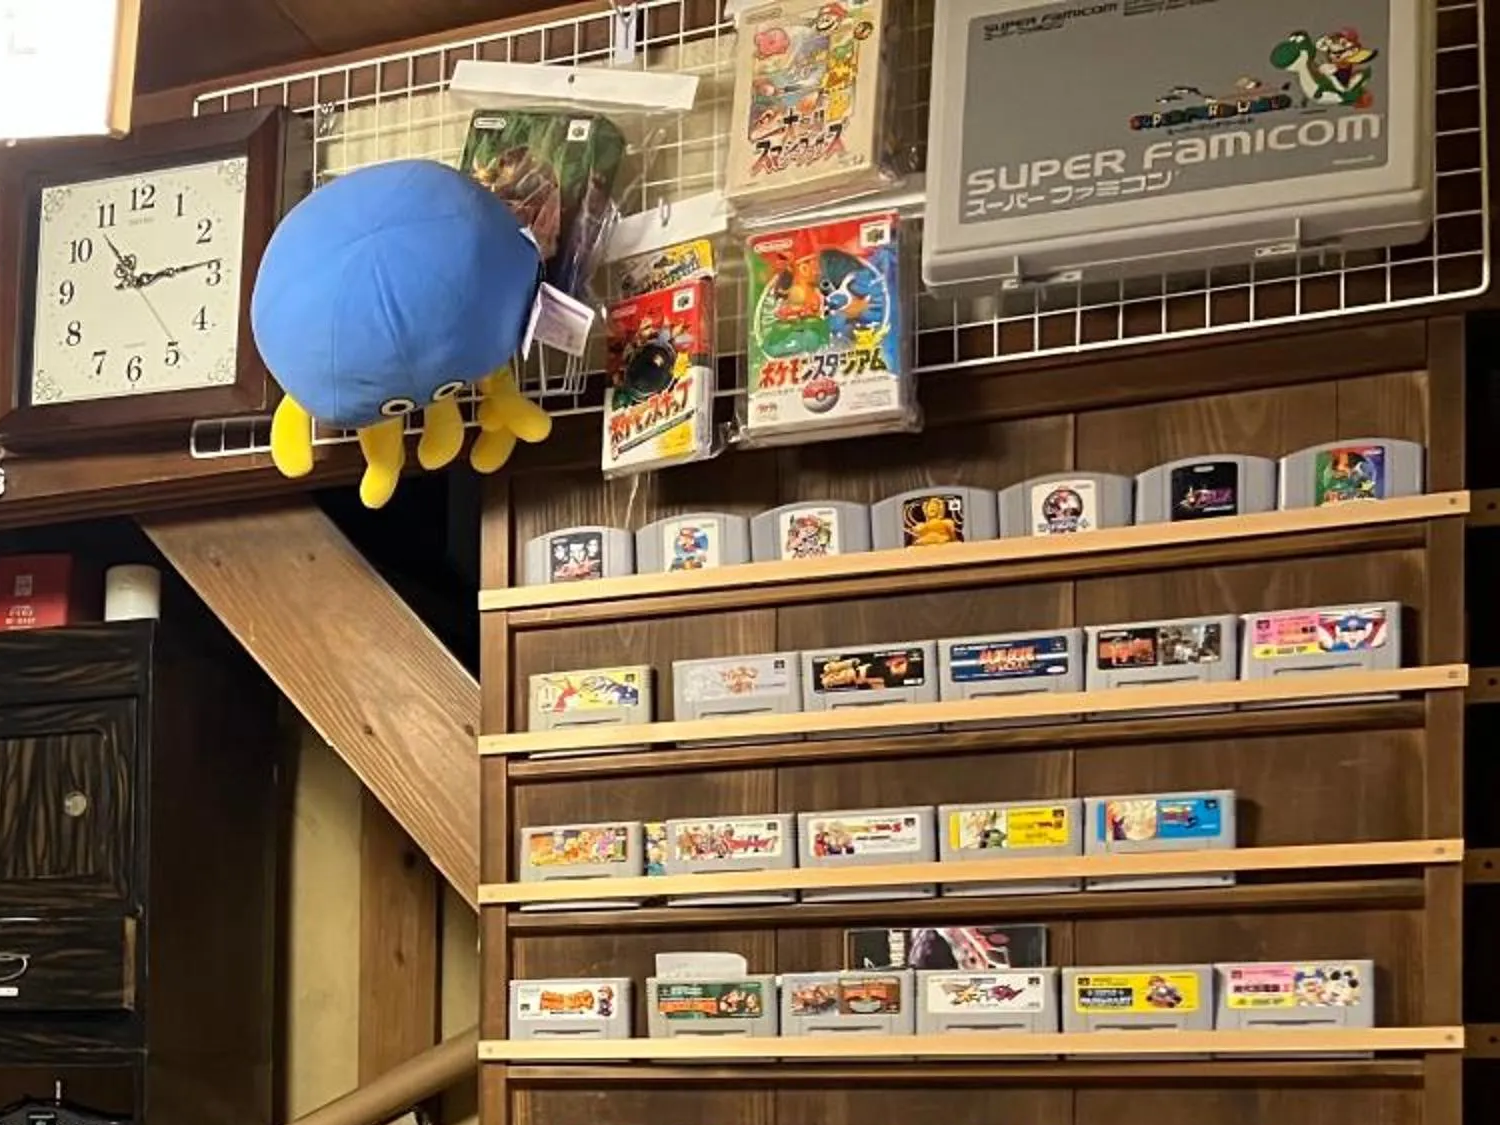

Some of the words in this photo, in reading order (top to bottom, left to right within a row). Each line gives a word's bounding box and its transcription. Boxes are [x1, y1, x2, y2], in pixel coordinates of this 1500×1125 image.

[967, 149, 1127, 198] SUPER
[130, 184, 156, 212] 12
[175, 194, 185, 218] 1
[967, 170, 1174, 218] スーパーファミコン
[97, 203, 116, 229] 11
[196, 219, 214, 245] 2
[69, 238, 93, 265] 10
[206, 260, 222, 287] 3
[59, 280, 75, 305] 9
[192, 306, 208, 331] 4
[66, 320, 82, 347] 8
[92, 350, 107, 376] 7
[165, 342, 179, 366] 5
[127, 356, 143, 383] 6
[759, 350, 889, 389] ポケモンスタジアム
